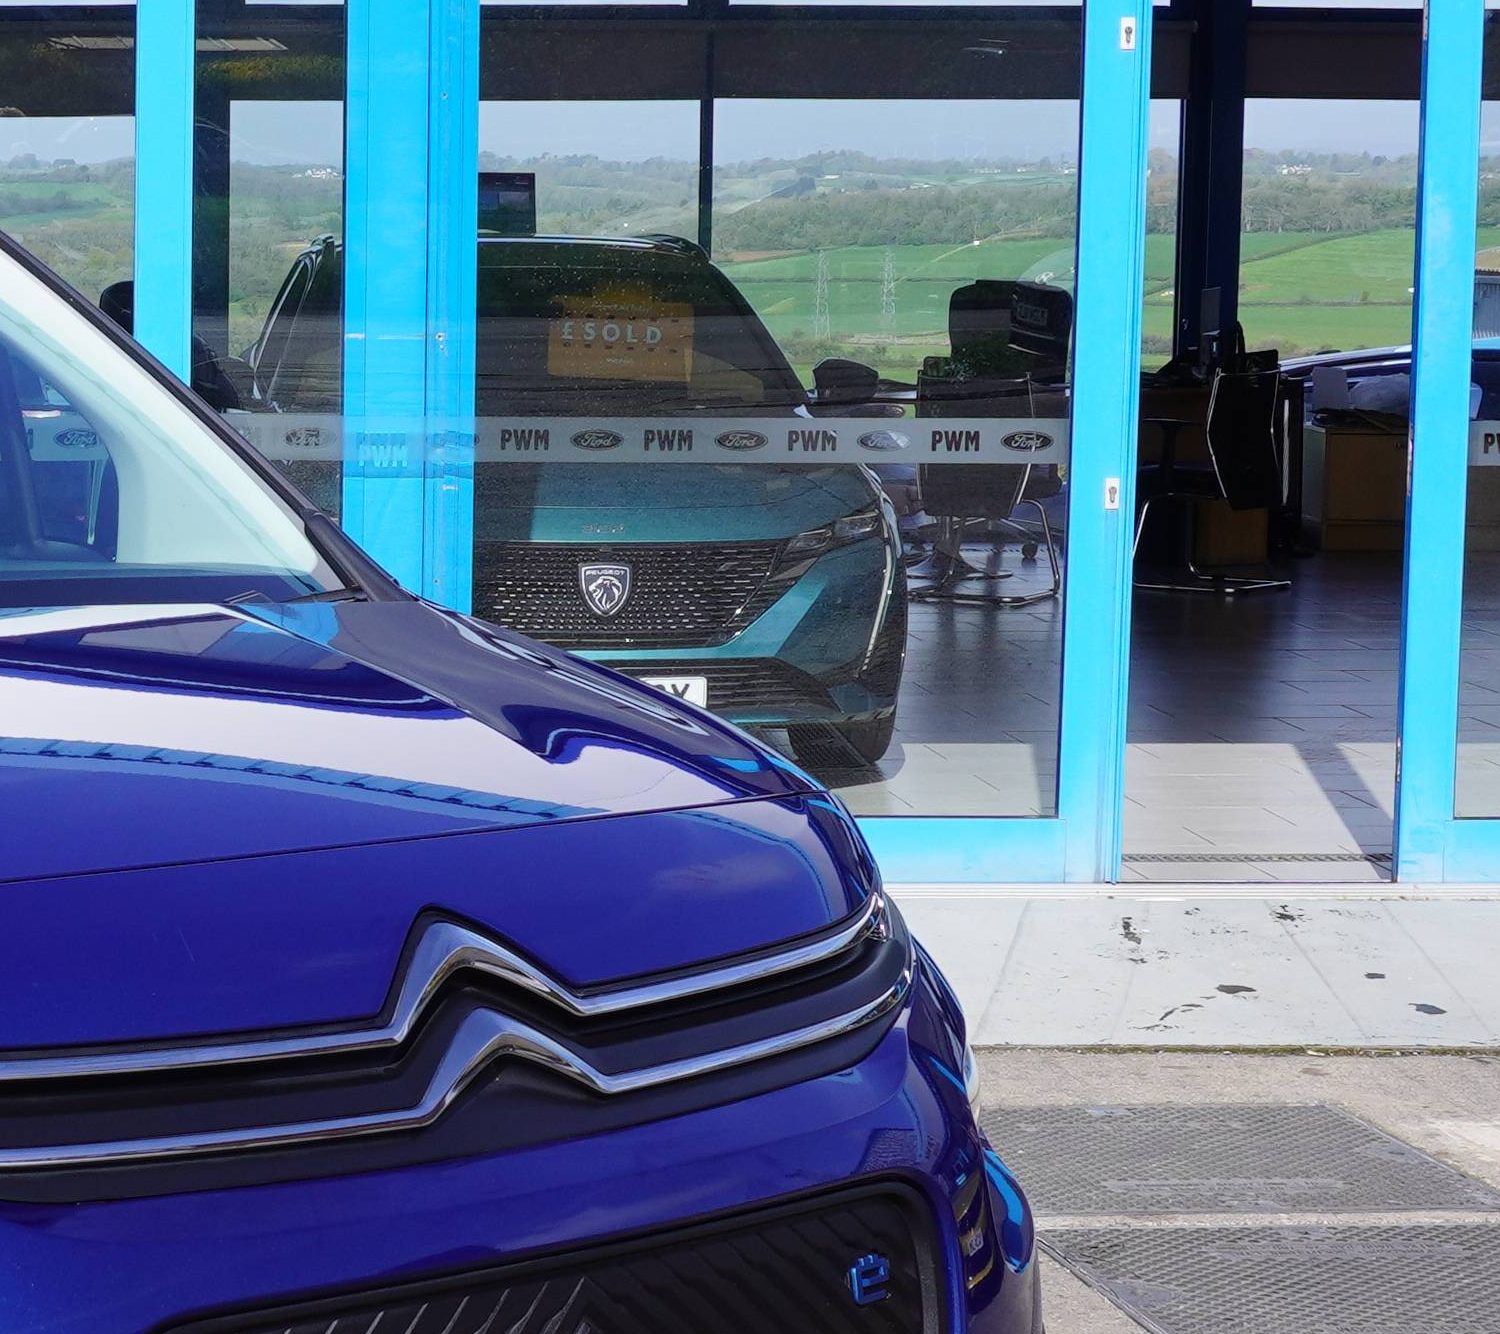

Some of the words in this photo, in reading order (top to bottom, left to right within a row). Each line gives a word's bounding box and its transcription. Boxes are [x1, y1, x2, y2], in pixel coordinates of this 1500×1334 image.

[501, 429, 549, 450] PWM
[643, 429, 693, 451] PWM
[788, 429, 837, 451] PWM
[931, 430, 980, 451] PWM
